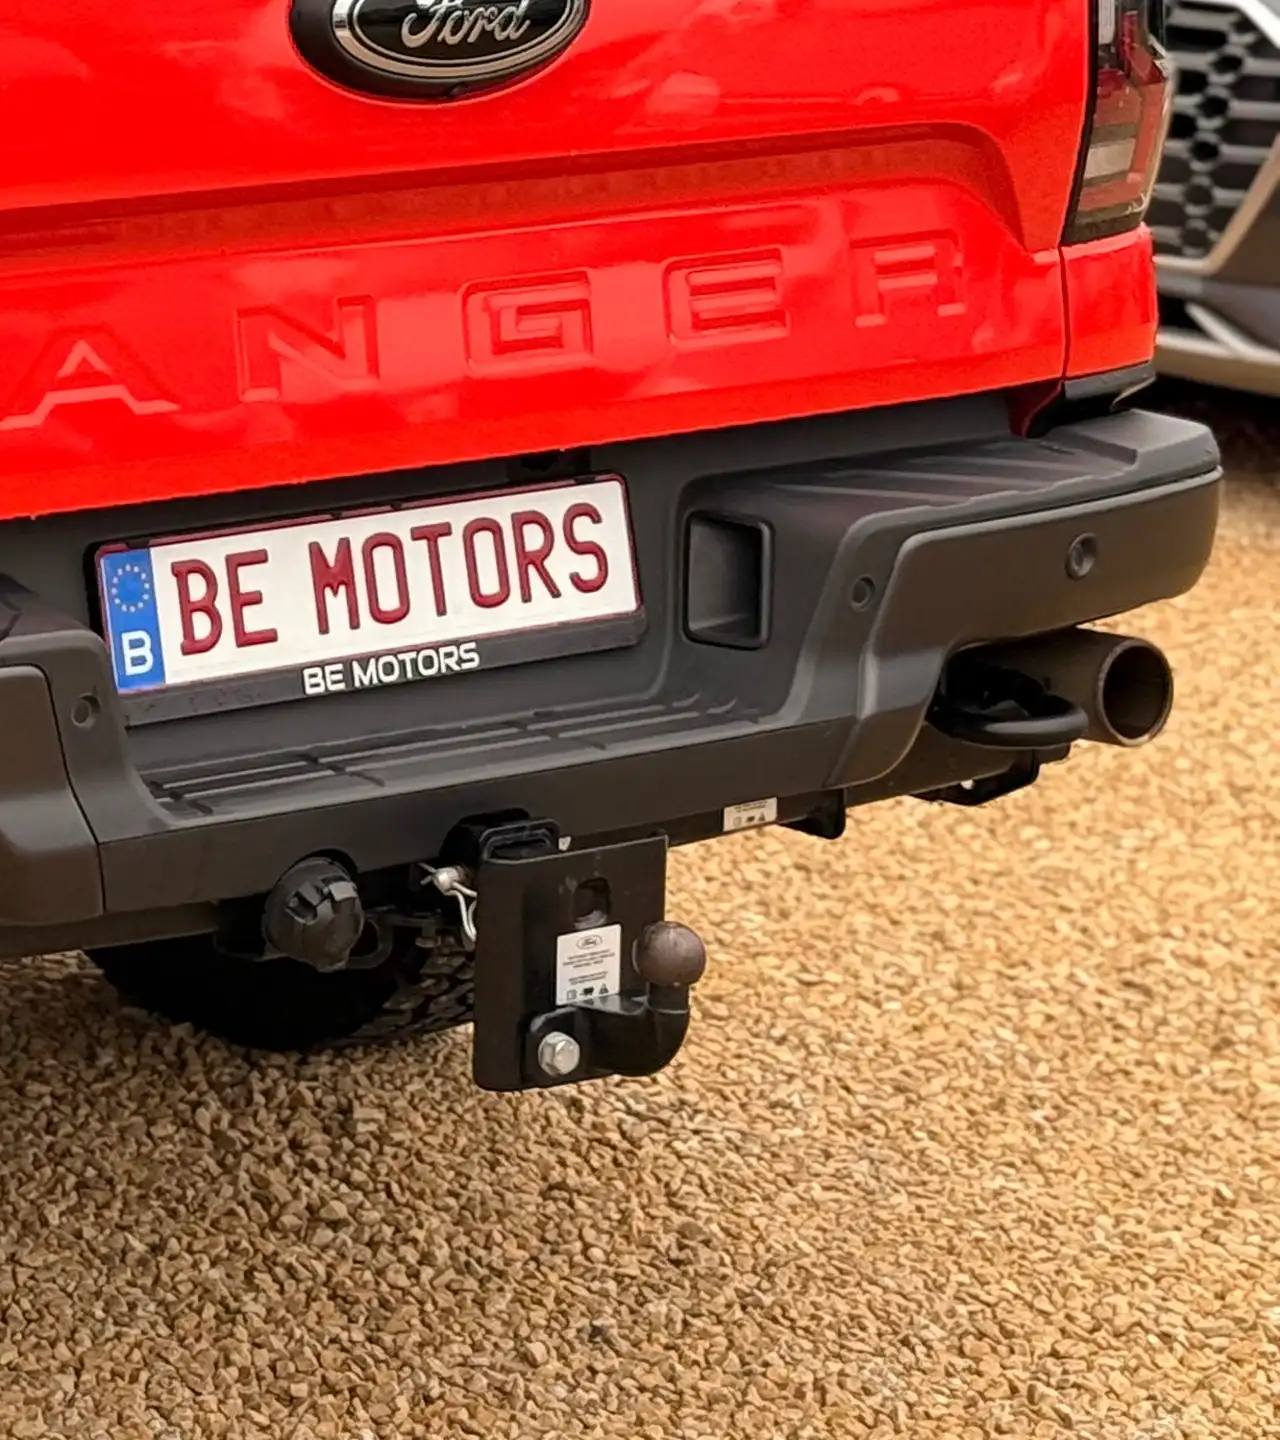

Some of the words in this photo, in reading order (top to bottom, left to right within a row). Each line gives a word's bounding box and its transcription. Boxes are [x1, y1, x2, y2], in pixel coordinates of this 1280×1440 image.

[170, 549, 278, 656] BE
[308, 502, 610, 635] MOTORS
[122, 629, 153, 676] B
[302, 663, 347, 696] BE
[352, 641, 481, 691] MOTORS
